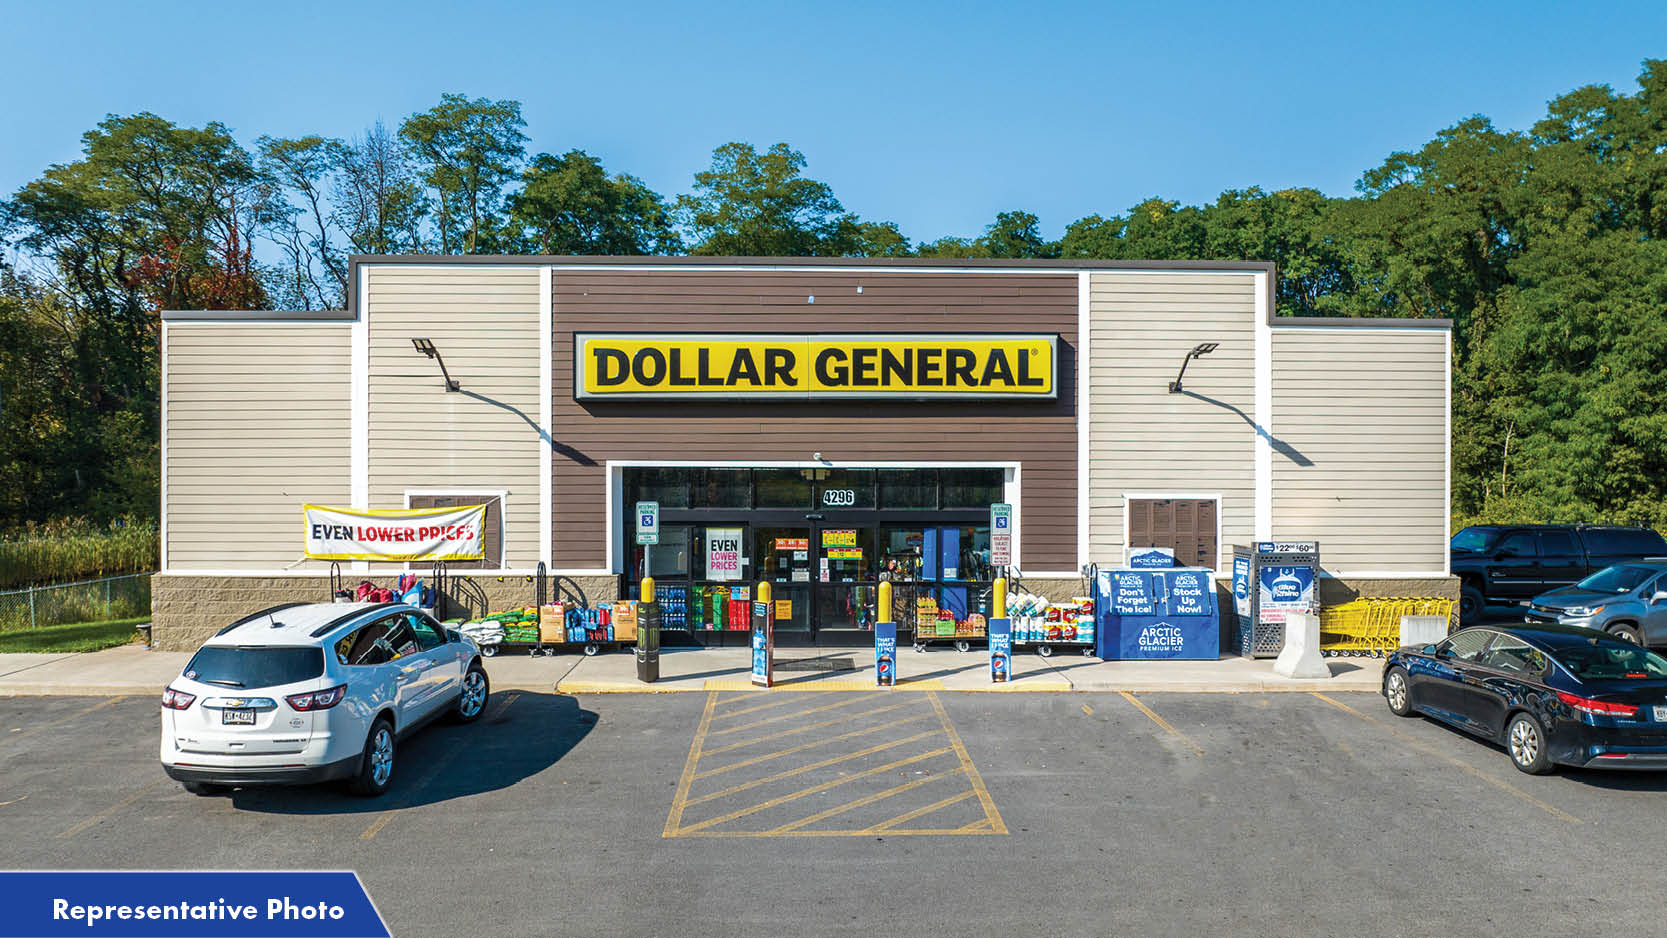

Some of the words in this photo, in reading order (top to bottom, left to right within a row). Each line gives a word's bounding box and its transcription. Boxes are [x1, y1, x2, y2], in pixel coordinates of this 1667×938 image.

[593, 346, 798, 387] DOLLAR
[814, 347, 1044, 387] GENERAL
[824, 491, 853, 504] 4296
[312, 524, 353, 540] EVEN
[357, 526, 415, 542] LOWER
[419, 525, 474, 542] PRICES
[711, 540, 738, 551] EVEN
[711, 552, 738, 561] LOWER
[710, 561, 737, 570] PRICES
[1118, 597, 1147, 605] Forget
[1182, 597, 1195, 605] Up
[1141, 628, 1181, 636] ARCTIC
[1139, 637, 1183, 645] GLACIER
